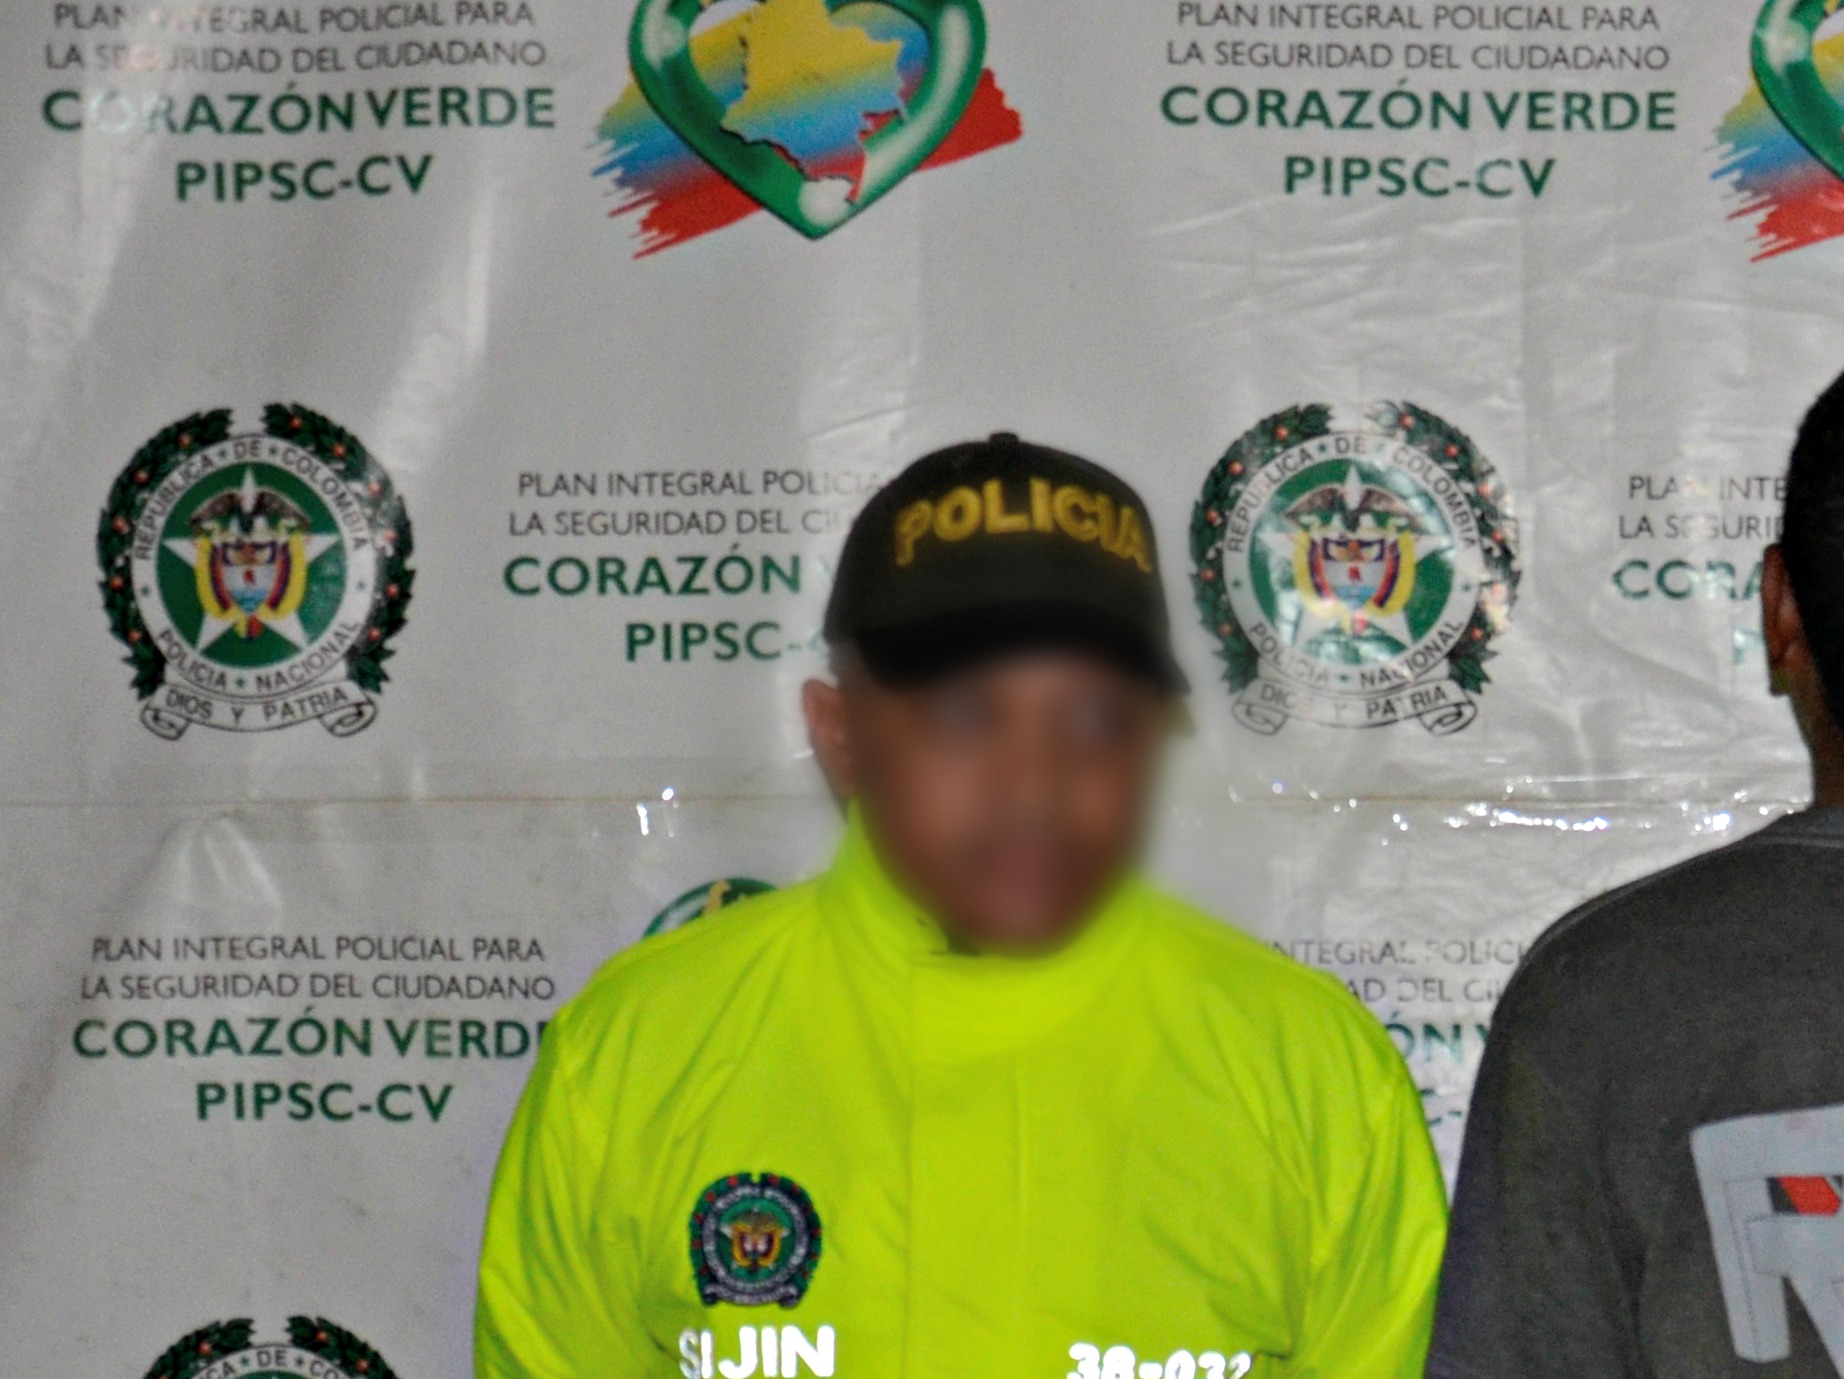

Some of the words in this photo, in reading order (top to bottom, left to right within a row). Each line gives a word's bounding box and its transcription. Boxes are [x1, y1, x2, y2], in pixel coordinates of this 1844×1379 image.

[319, 2, 443, 32] POLICIAL
[455, 1, 535, 27] PARA
[1177, 3, 1258, 30] PLAN
[1269, 3, 1422, 30] INTEGRAL
[1434, 4, 1572, 31] POLICIAL
[1581, 6, 1660, 32] PARA
[46, 43, 84, 69] LA
[292, 49, 346, 73] DEL
[355, 40, 547, 70] CIUDADANO
[1166, 42, 1201, 67] LA
[1215, 41, 1393, 69] SEGURIDAD
[1404, 43, 1461, 70] DEL
[1471, 43, 1670, 71] CIUDADANO
[42, 81, 355, 134] CORAZÓN
[365, 86, 555, 127] VERDE
[1161, 79, 1470, 130] CORAZÓN
[1483, 90, 1677, 132] VERDE
[176, 154, 434, 201] PIPSC-CV
[1284, 155, 1557, 198] PIPSC-CV
[136, 454, 214, 560] REPUBLICA
[234, 441, 262, 458] DE
[282, 449, 369, 549] COLOMBIA
[519, 472, 597, 497] PLAN
[608, 472, 752, 497] INTEGRAL
[1336, 438, 1361, 454] DE
[1394, 448, 1477, 546] COLOMBIA
[509, 511, 544, 536] LA
[555, 511, 726, 535] SEGURIDAD
[736, 509, 791, 534] DEL
[896, 475, 1151, 573] POLICIA
[1619, 516, 1654, 538] LA
[504, 544, 802, 596] CORAZÓN
[159, 629, 228, 686] POLICIA
[256, 621, 359, 688] NACIONAL
[166, 689, 212, 720] DIOS
[231, 707, 245, 724] Y
[264, 686, 348, 720] PATRIA
[92, 938, 162, 962] PLAN
[174, 937, 325, 960] INTEGRAL
[336, 937, 462, 961] POLICIAL
[472, 940, 545, 962] PARA
[81, 976, 110, 999] LA
[121, 975, 300, 998] SEGURIDAD
[309, 974, 363, 998] DEL
[372, 976, 556, 1000] CIUDADANO
[73, 1007, 372, 1056] CORAZÓN
[196, 1082, 454, 1122] PIPSC-CV
[256, 1351, 287, 1367] DE
[679, 1326, 835, 1379] SIJIN
